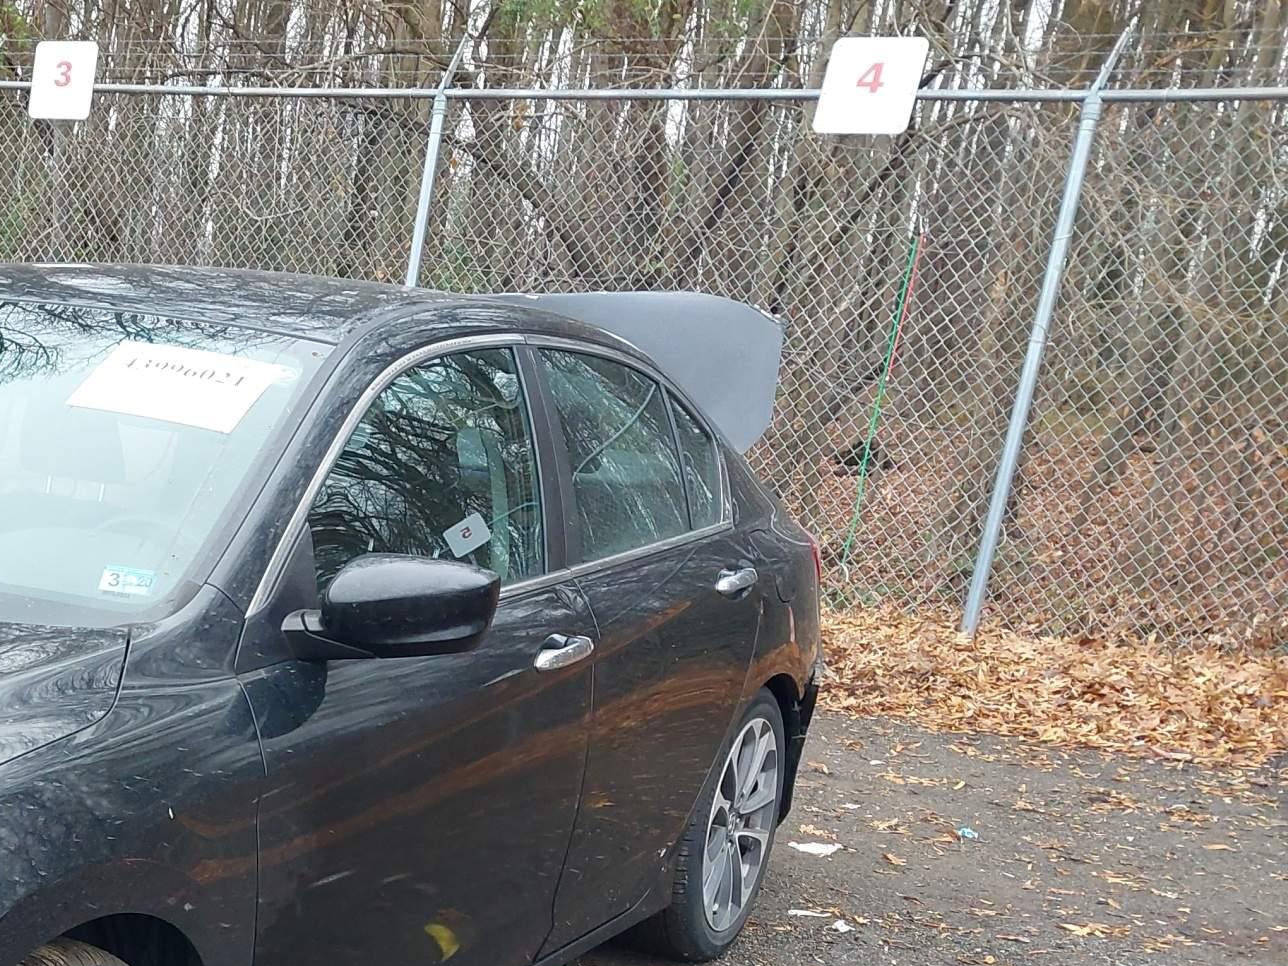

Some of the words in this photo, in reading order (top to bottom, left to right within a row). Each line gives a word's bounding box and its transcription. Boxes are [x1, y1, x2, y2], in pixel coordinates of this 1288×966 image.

[54, 61, 73, 87] 3
[856, 61, 886, 94] 4
[108, 572, 121, 587] 3
